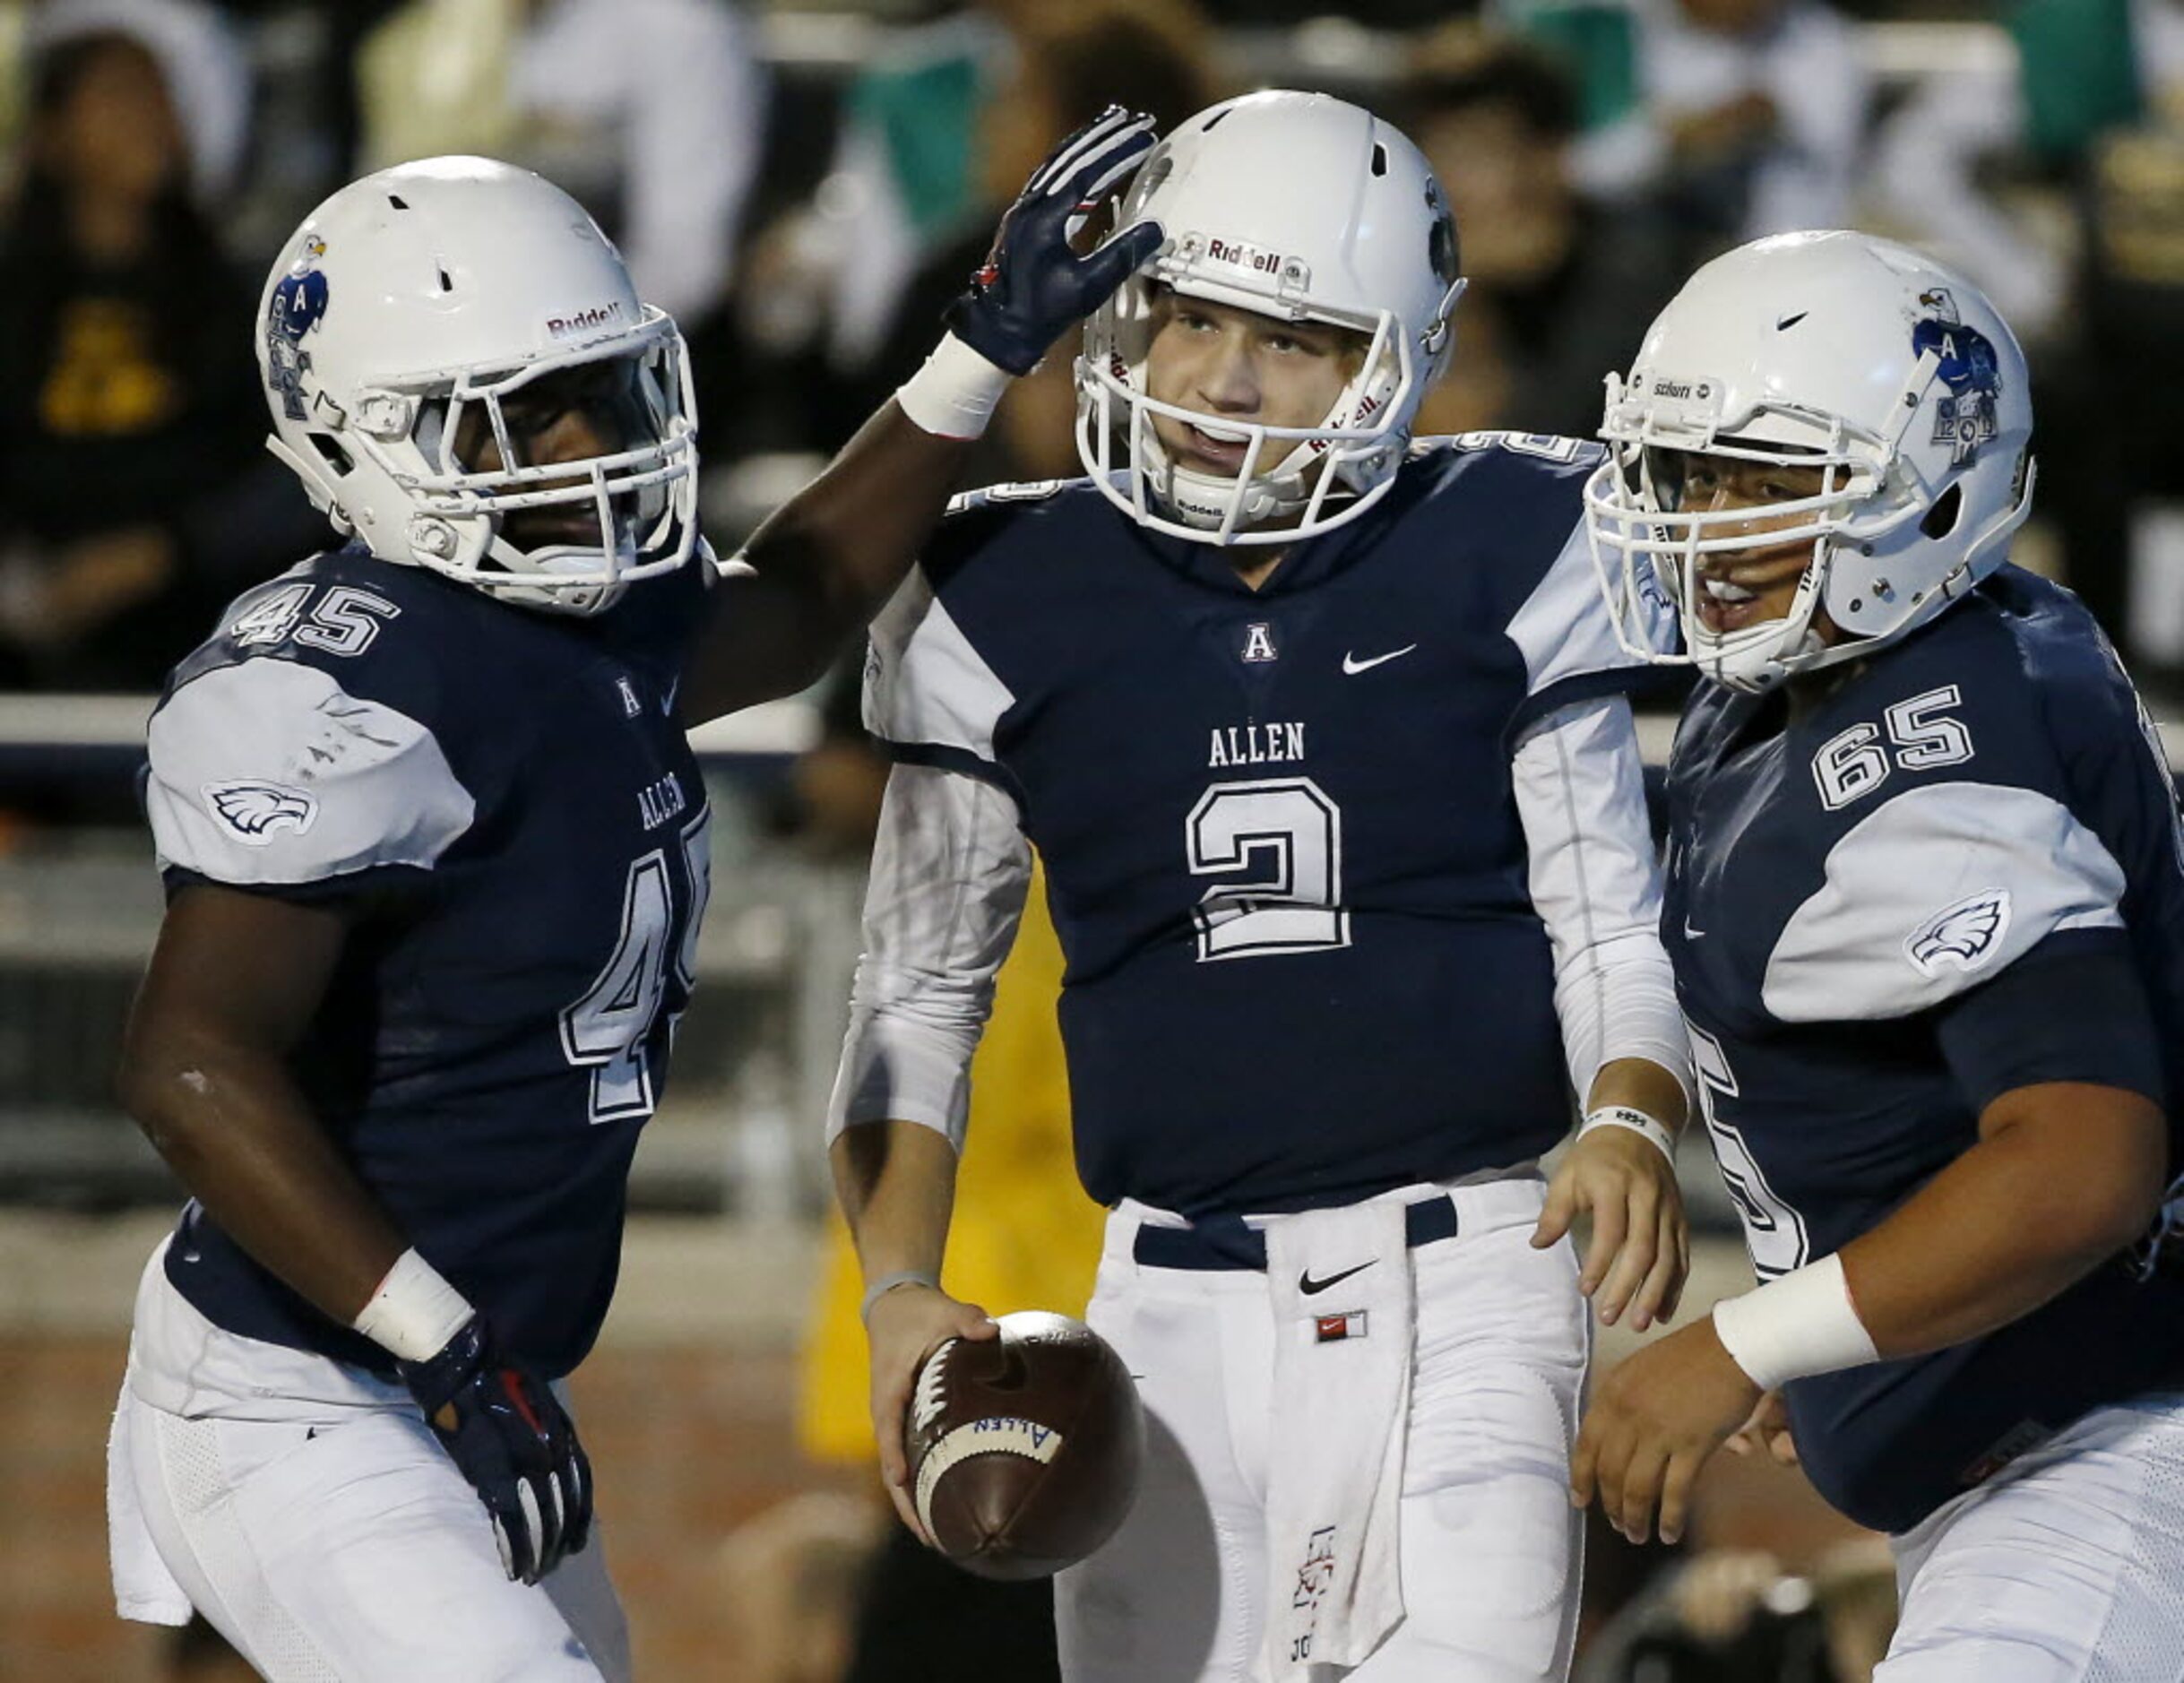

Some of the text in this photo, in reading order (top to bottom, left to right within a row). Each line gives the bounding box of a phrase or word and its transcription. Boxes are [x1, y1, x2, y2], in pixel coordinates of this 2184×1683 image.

[293, 283, 306, 313] A
[1940, 332, 1958, 361] A
[231, 584, 402, 657] 45
[1241, 622, 1277, 663] A
[616, 677, 642, 718] A
[1209, 721, 1305, 767] ALLEN
[1811, 684, 1975, 811] 65
[1186, 776, 1351, 963] 2
